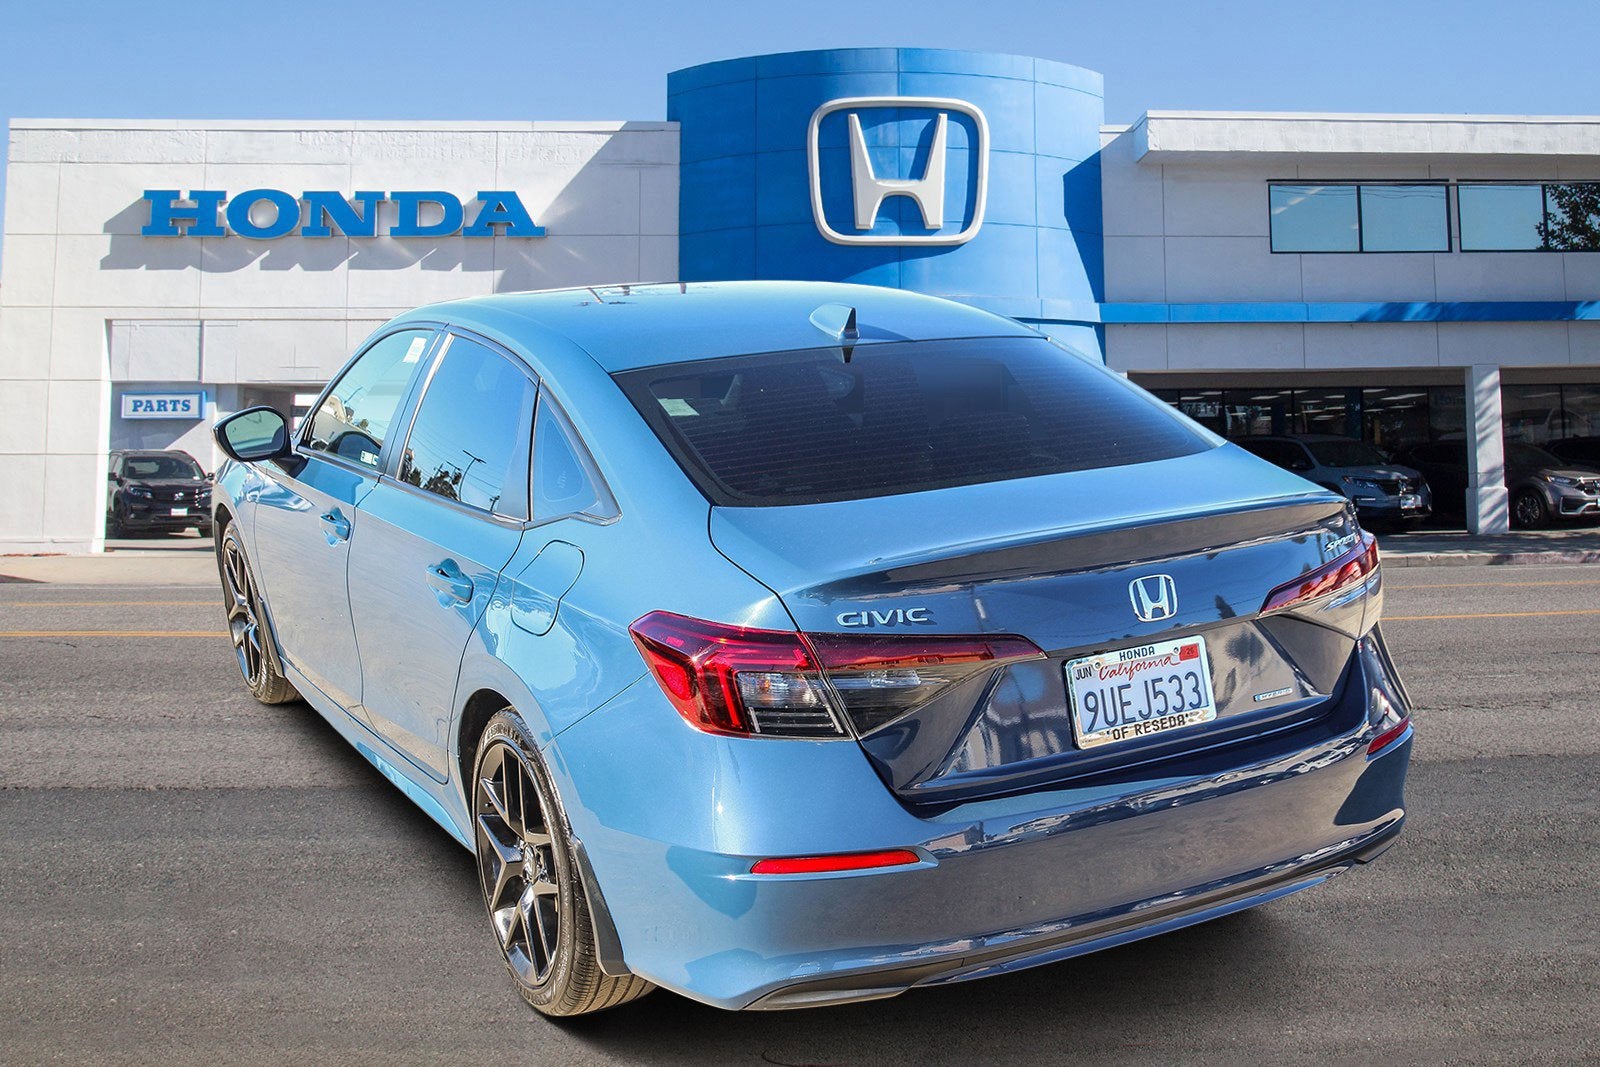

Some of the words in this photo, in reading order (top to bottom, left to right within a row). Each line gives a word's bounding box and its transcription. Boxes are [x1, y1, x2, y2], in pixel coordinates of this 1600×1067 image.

[141, 189, 548, 239] HONDA
[132, 399, 191, 412] PARTS
[836, 607, 928, 626] CIVIC
[1120, 646, 1155, 661] HONDA
[1075, 666, 1092, 680] JUN
[1099, 652, 1180, 681] California
[1084, 671, 1203, 732] 9UEJ533
[1112, 726, 1130, 740] OF
[1135, 713, 1185, 736] RESEDA
